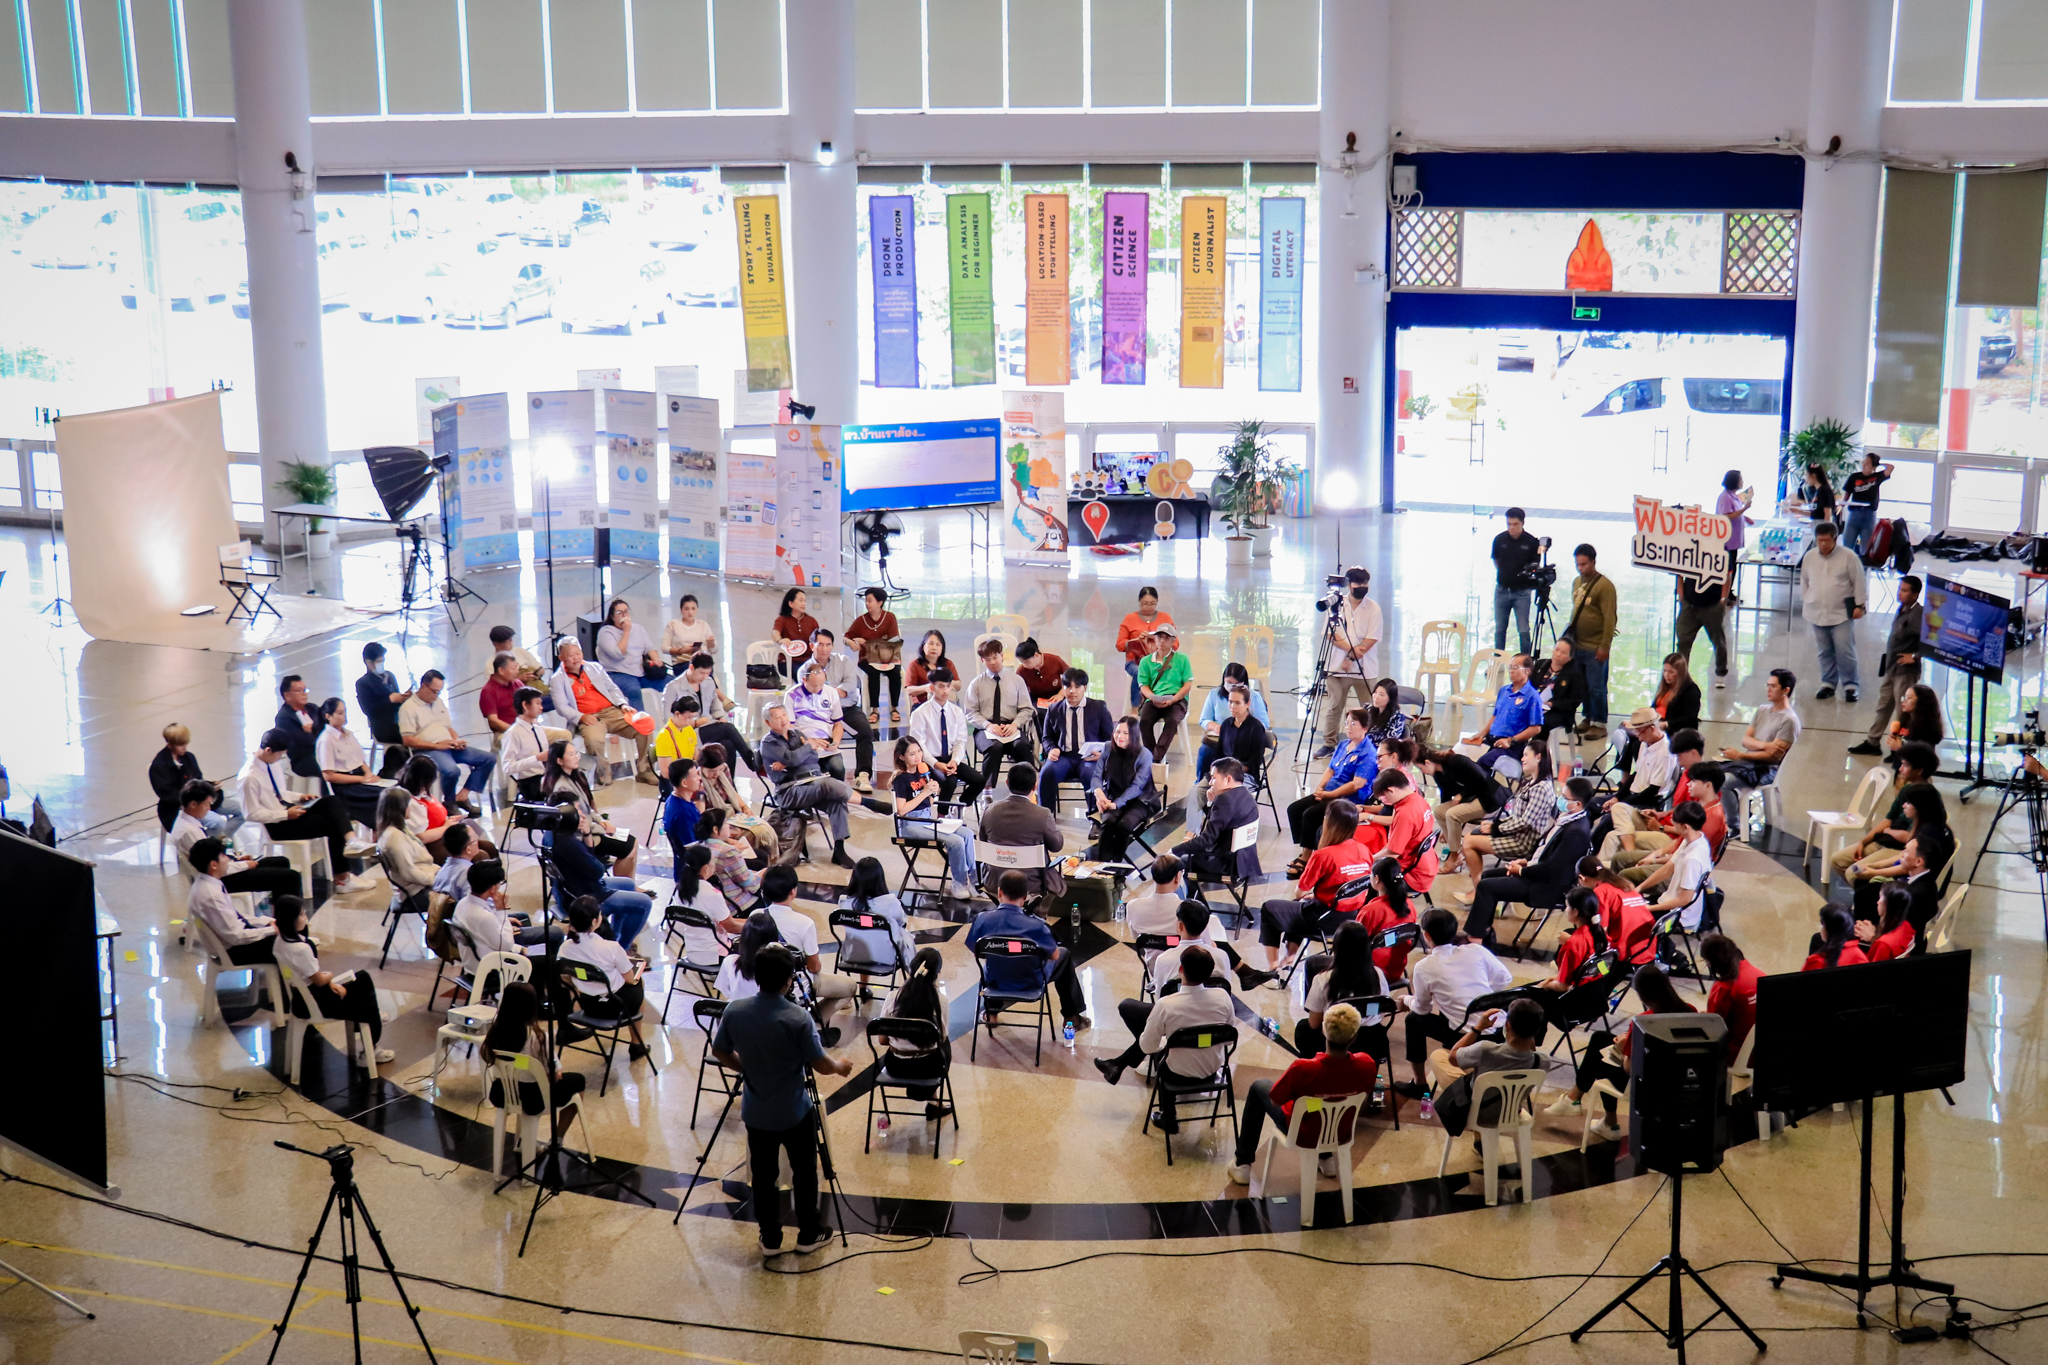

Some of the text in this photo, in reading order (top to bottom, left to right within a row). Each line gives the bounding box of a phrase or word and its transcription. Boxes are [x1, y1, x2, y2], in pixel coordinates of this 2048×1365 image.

[744, 203, 755, 285] STORY-TELLING
[764, 213, 775, 283] VISUALISATION
[882, 237, 892, 277] DRONE
[894, 210, 904, 277] PRODUCTION
[961, 251, 969, 279] DATA
[1037, 201, 1045, 280] LOCATION-BASED
[1112, 215, 1124, 277] CITIZEN
[1128, 229, 1137, 278] SCIENCE
[1192, 232, 1201, 274] CITIZEN
[1206, 207, 1216, 274] JOURNALIST
[1272, 229, 1281, 279] DIGITAL
[1285, 229, 1294, 279] LITERACY
[1635, 498, 1728, 540] ฟังเสียง
[1633, 535, 1726, 573] ประเทศไทย
